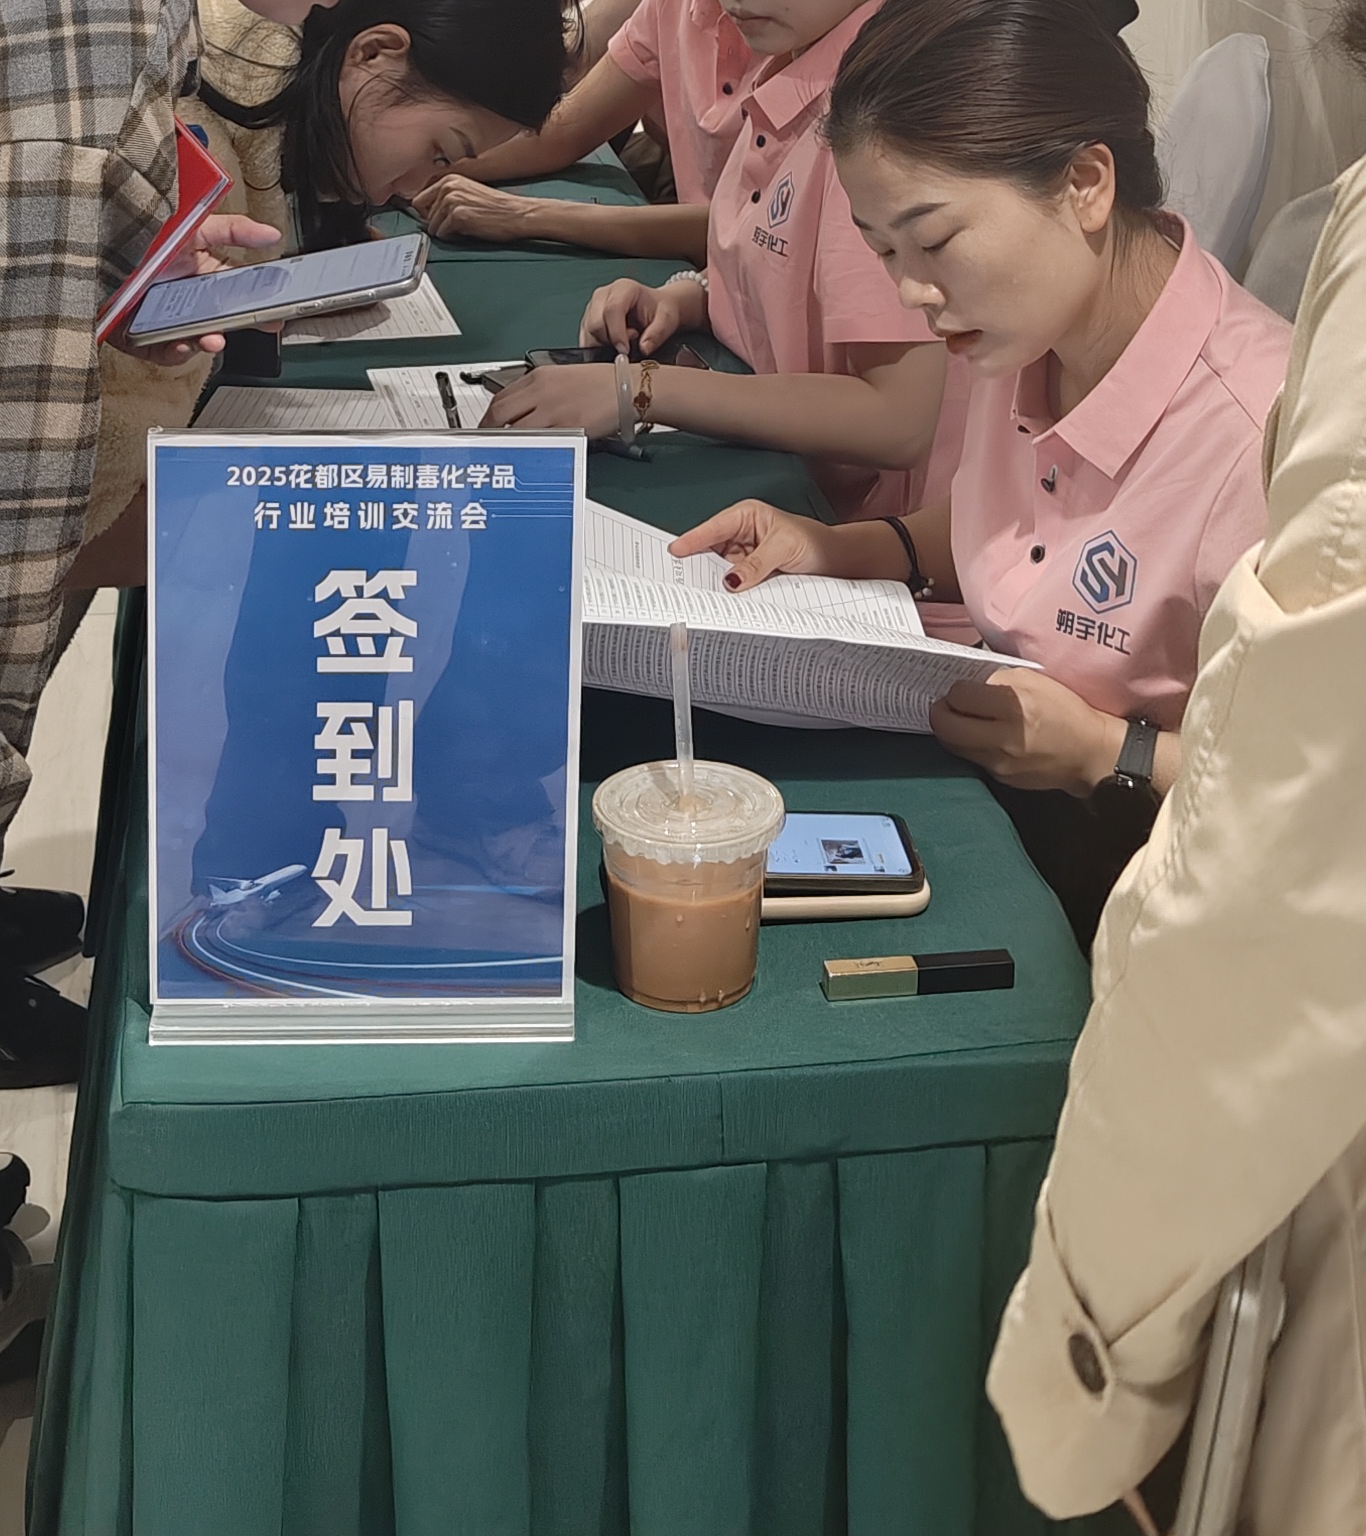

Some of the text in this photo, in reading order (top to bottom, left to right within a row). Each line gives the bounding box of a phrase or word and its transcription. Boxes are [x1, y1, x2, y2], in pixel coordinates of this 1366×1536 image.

[226, 463, 516, 490] 2025花都区易制毒化学品
[253, 501, 488, 530] 行业培训交流会
[1056, 608, 1131, 656] 朔宇化工
[311, 569, 419, 928] 签到处
